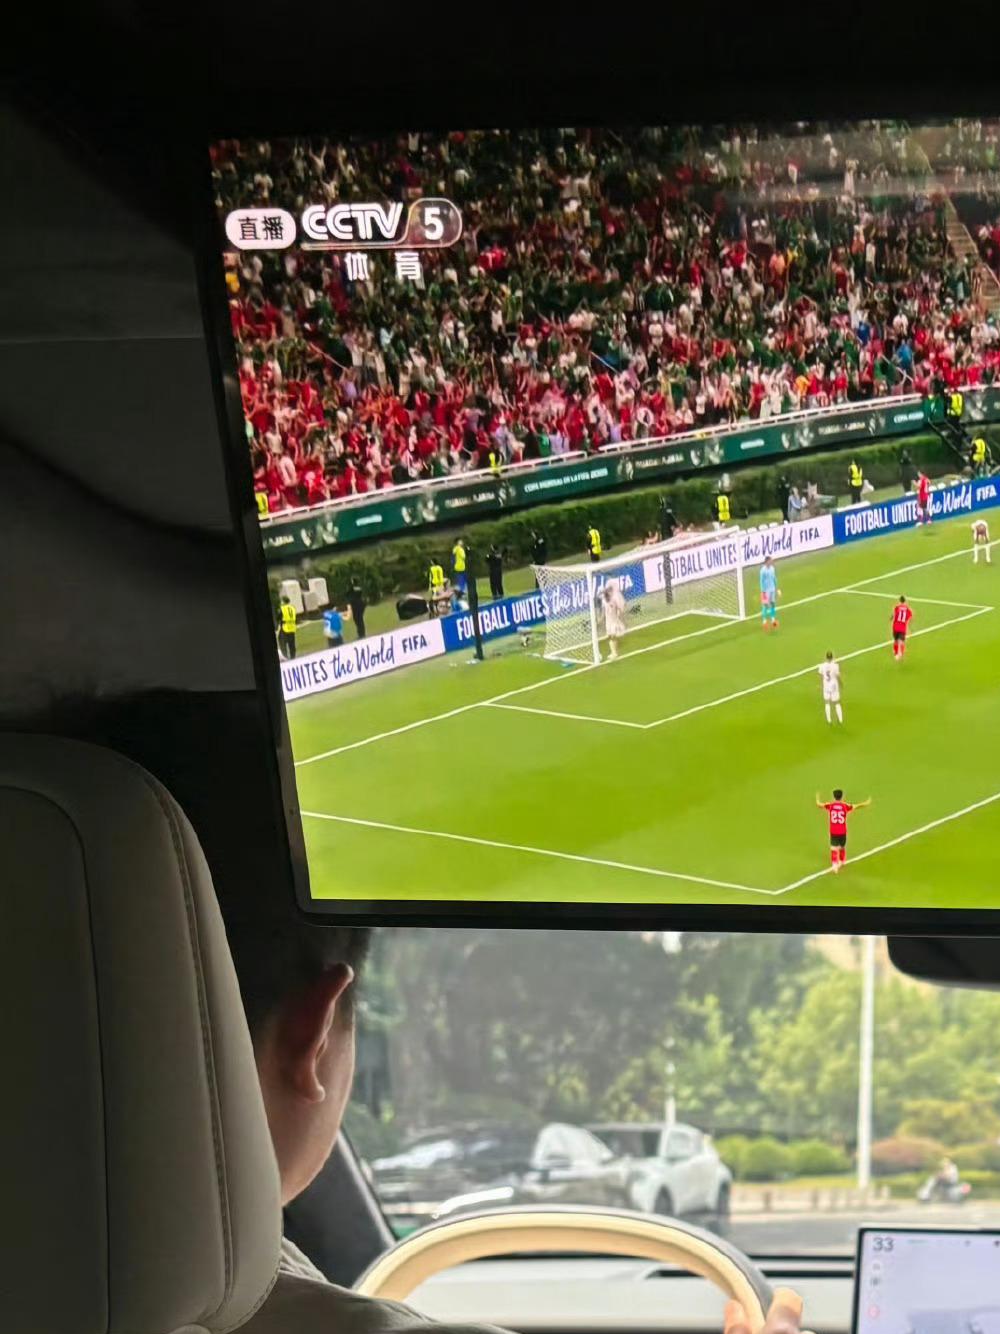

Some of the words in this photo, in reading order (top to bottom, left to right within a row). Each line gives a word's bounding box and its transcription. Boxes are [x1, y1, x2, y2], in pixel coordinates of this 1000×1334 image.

[237, 215, 284, 241] 直播
[302, 201, 404, 240] CCTV
[424, 207, 444, 240] 5
[344, 251, 421, 281] 体育
[845, 507, 890, 536] FOOTBALL
[943, 484, 972, 514] World
[976, 483, 997, 502] FIFA
[741, 535, 760, 562] the
[761, 527, 794, 557] World
[800, 527, 820, 543] FIFA
[511, 592, 550, 625] UNITES
[283, 660, 329, 692] UNITES
[328, 650, 353, 680] the
[354, 635, 395, 673] World
[402, 634, 428, 654] FIFA
[873, 1235, 895, 1253] 33
